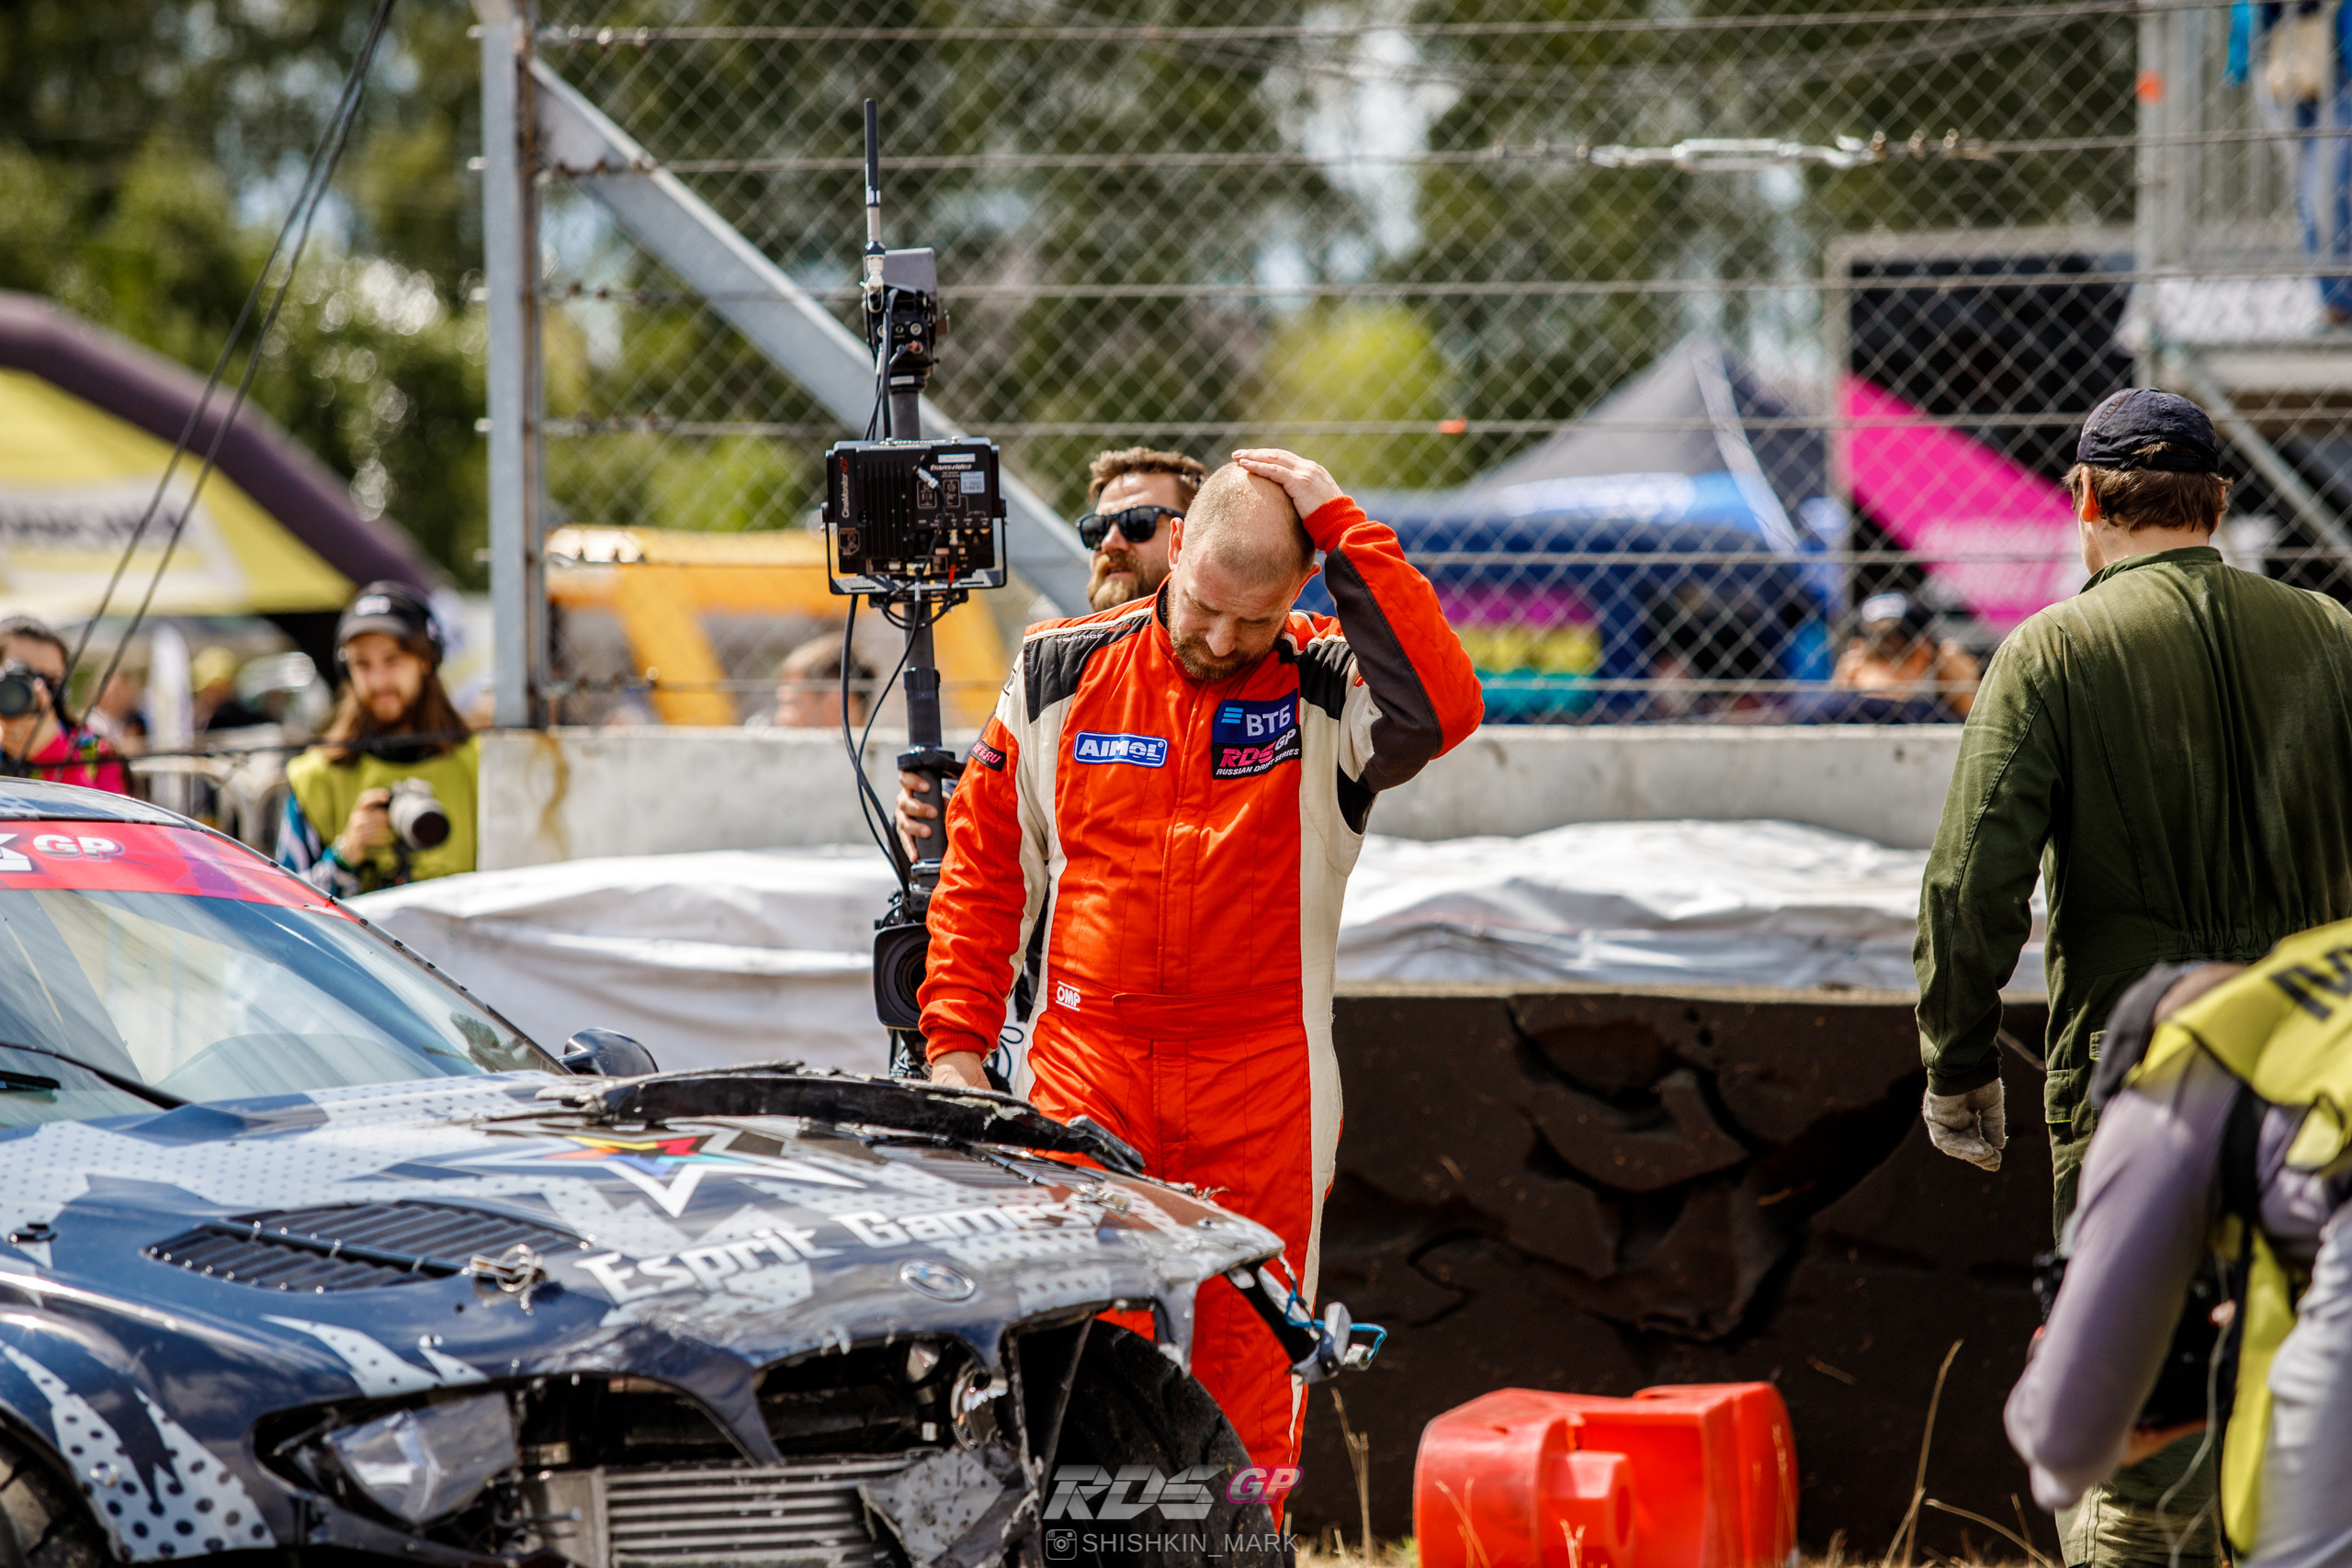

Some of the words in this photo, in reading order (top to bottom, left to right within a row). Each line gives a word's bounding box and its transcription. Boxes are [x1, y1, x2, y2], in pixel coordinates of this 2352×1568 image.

[1246, 705, 1291, 737] ВТБ
[1216, 766, 1253, 776] RUSSIAN
[1253, 758, 1275, 773] DRIFT
[1274, 748, 1300, 762] SERIES
[1219, 740, 1277, 767] RDS
[1274, 728, 1296, 750] GP
[32, 833, 121, 860] GP
[1057, 986, 1081, 1008] OMP
[573, 1228, 845, 1304] Esprit
[829, 1203, 1095, 1248] Games
